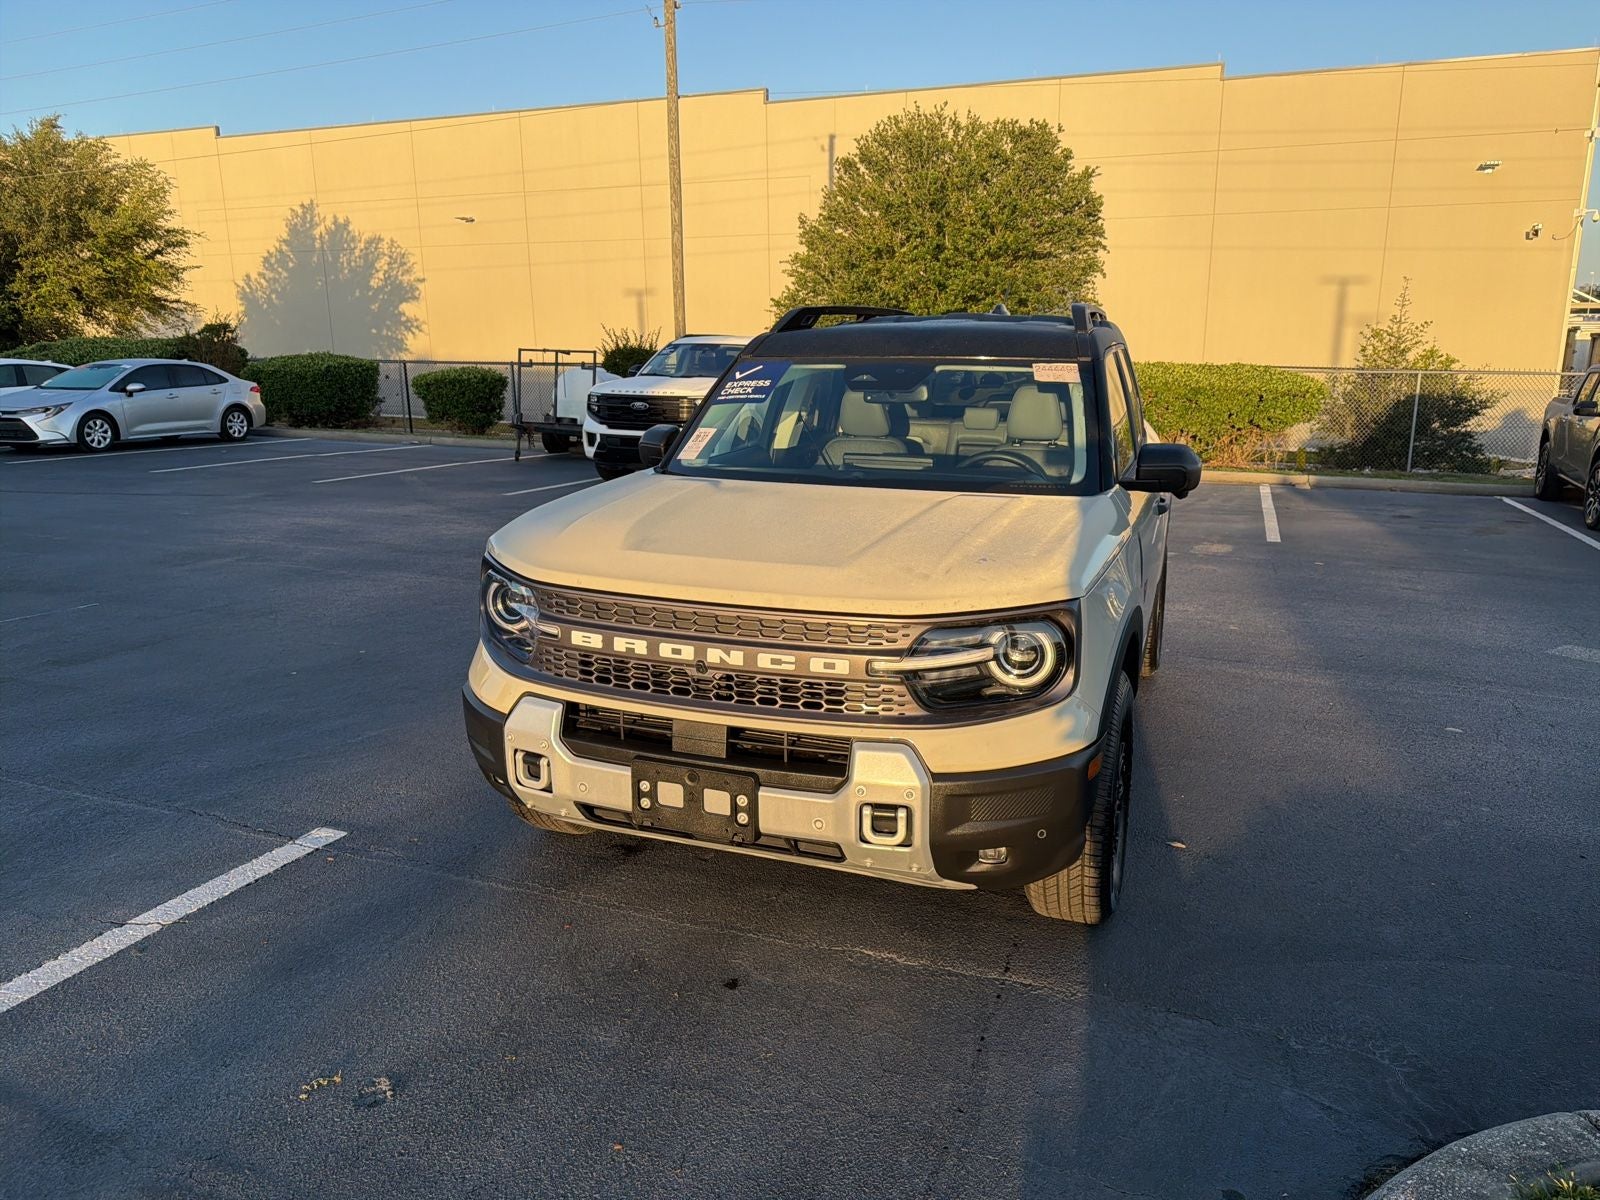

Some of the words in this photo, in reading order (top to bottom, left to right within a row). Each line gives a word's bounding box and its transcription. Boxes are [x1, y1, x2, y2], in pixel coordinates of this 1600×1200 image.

[725, 380, 771, 388] EXPRESS
[721, 387, 754, 395] CHECK
[570, 630, 850, 675] BRONCO
